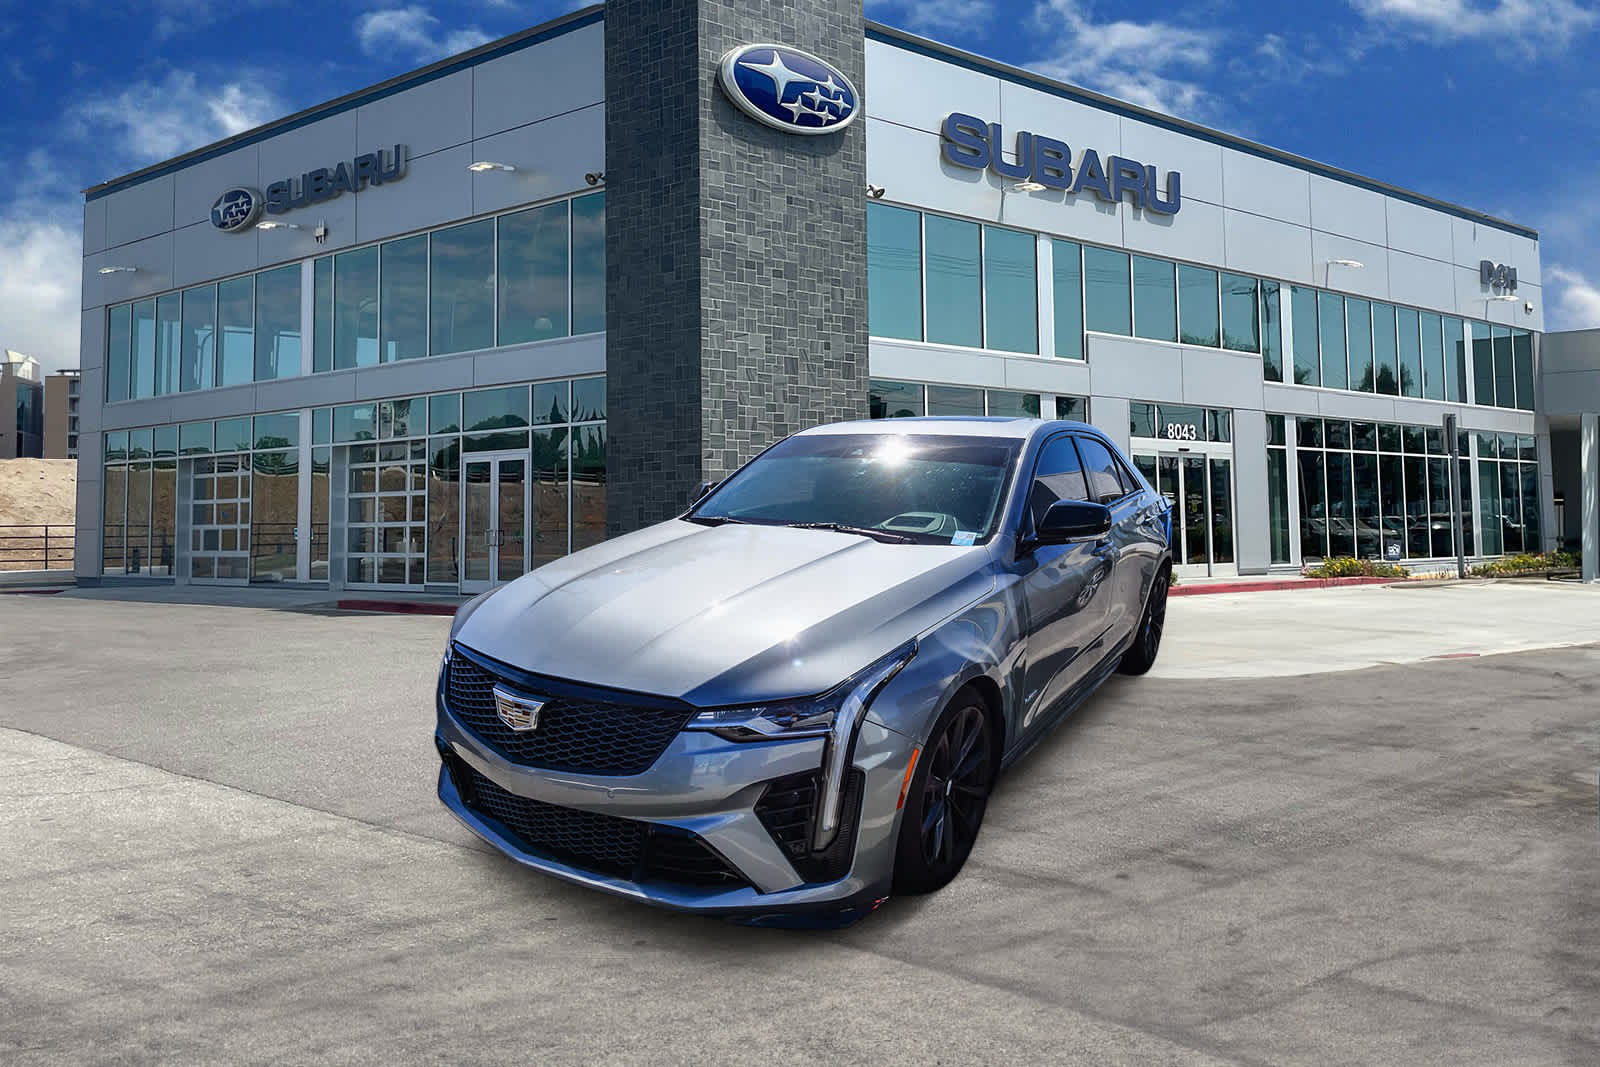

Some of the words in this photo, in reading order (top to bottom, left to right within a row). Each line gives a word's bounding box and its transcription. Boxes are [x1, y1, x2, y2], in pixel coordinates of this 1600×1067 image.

[265, 144, 404, 214] SUBARU
[942, 112, 1181, 214] SUBARU
[1167, 423, 1196, 440] 8043
